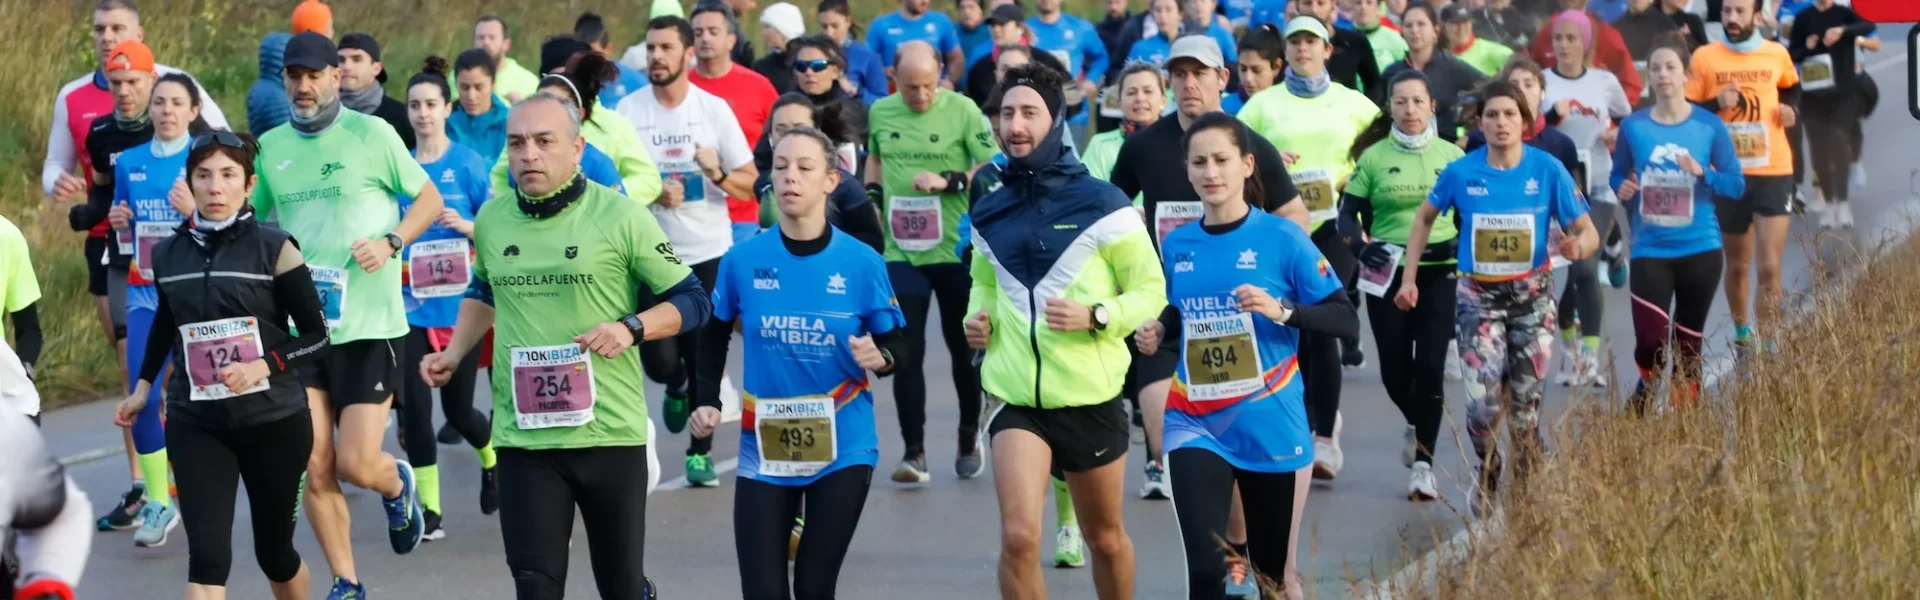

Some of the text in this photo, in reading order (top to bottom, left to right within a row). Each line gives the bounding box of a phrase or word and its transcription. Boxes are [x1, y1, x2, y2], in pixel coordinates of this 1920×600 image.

[652, 134, 691, 146] U-run
[902, 216, 927, 231] 389
[1489, 235, 1519, 252] 443
[427, 259, 454, 276] 143
[492, 273, 594, 287] SUSODELAFUENTE
[753, 279, 780, 290] IBIZA
[1180, 295, 1238, 312] VUELA
[761, 315, 826, 332] VUELA
[760, 328, 836, 346] EN IBIZA
[205, 344, 242, 369] 124
[1202, 344, 1238, 369] 494
[533, 373, 572, 397] 254
[779, 427, 815, 449] 493
